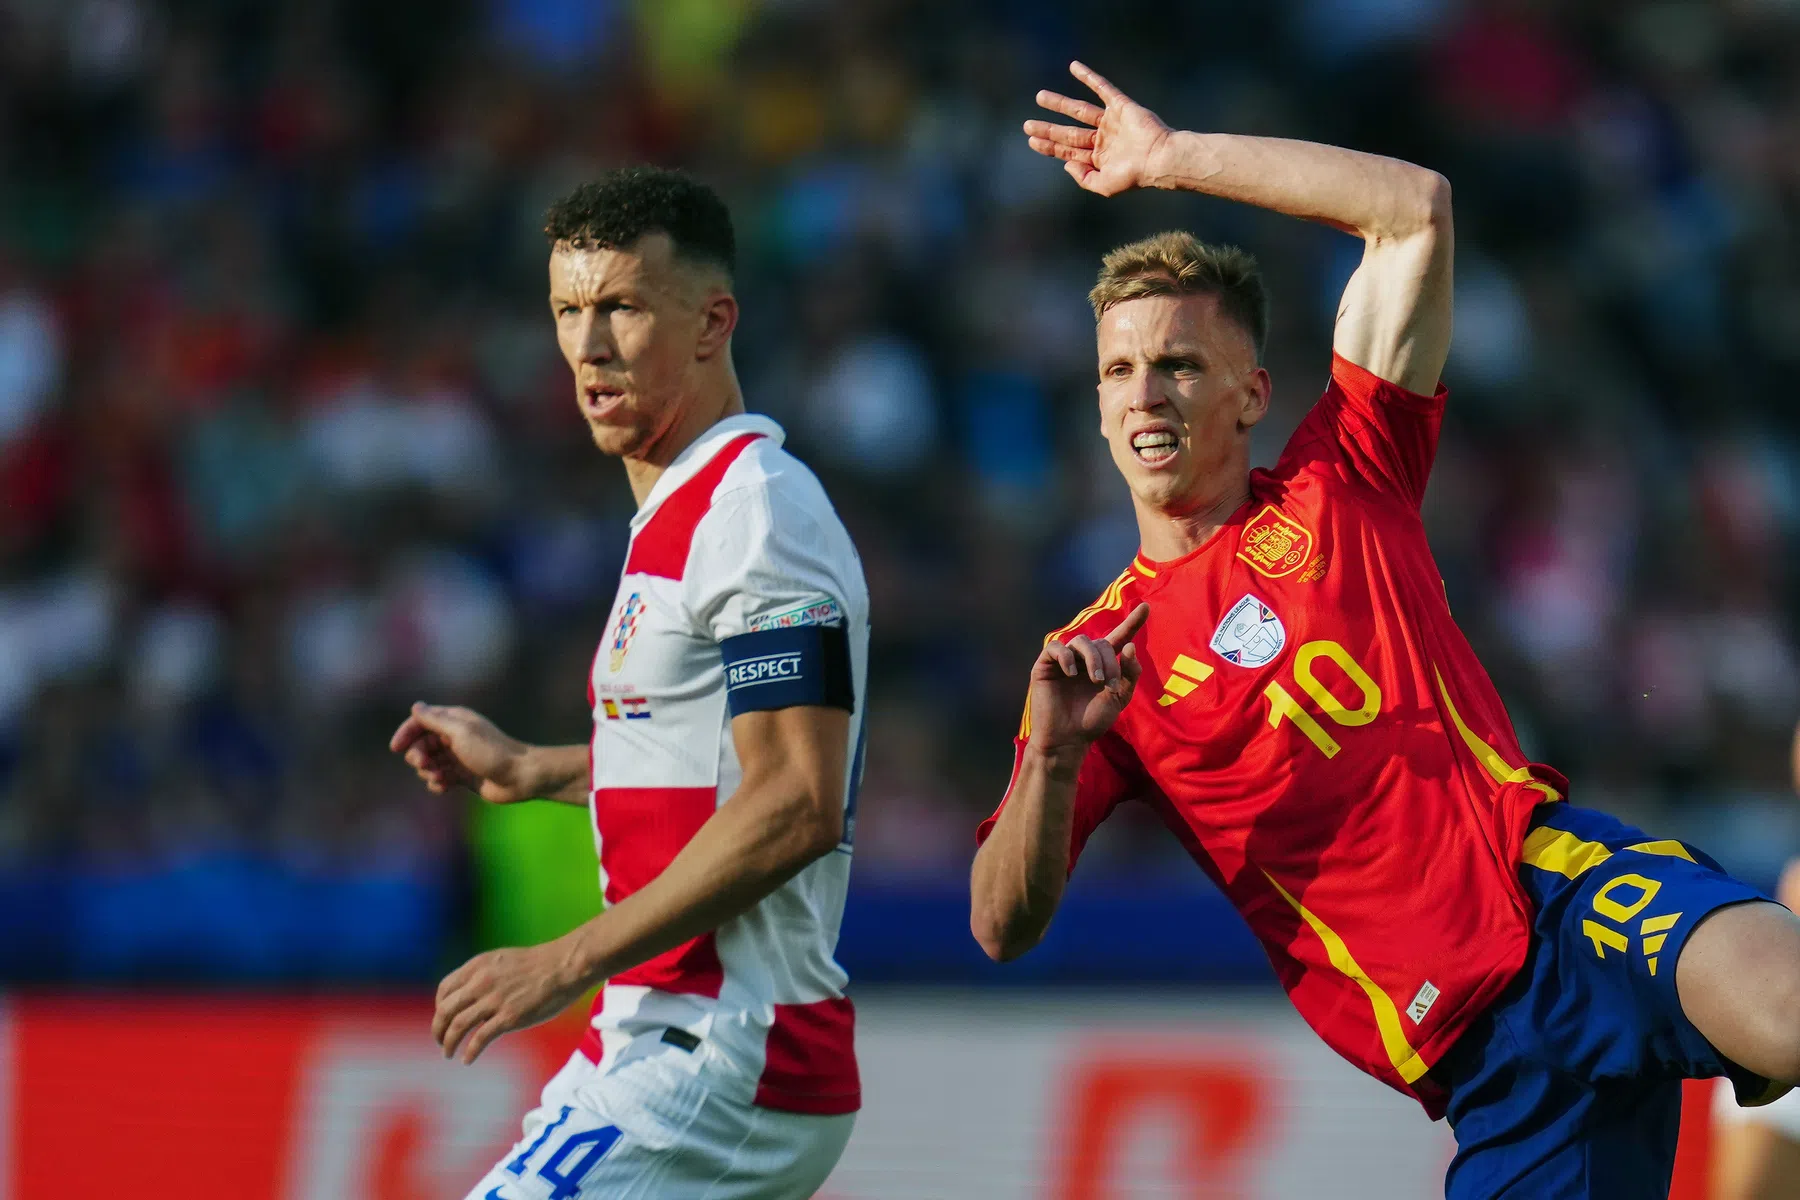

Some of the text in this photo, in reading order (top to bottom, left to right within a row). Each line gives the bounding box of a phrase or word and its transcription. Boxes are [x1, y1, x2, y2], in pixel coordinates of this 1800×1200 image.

[1219, 612, 1236, 632] NATIONS
[1233, 596, 1250, 614] LEAGUE
[729, 657, 801, 684] RESPECT
[1263, 640, 1382, 759] 10
[1582, 873, 1662, 959] 10
[506, 1106, 624, 1200] 14
